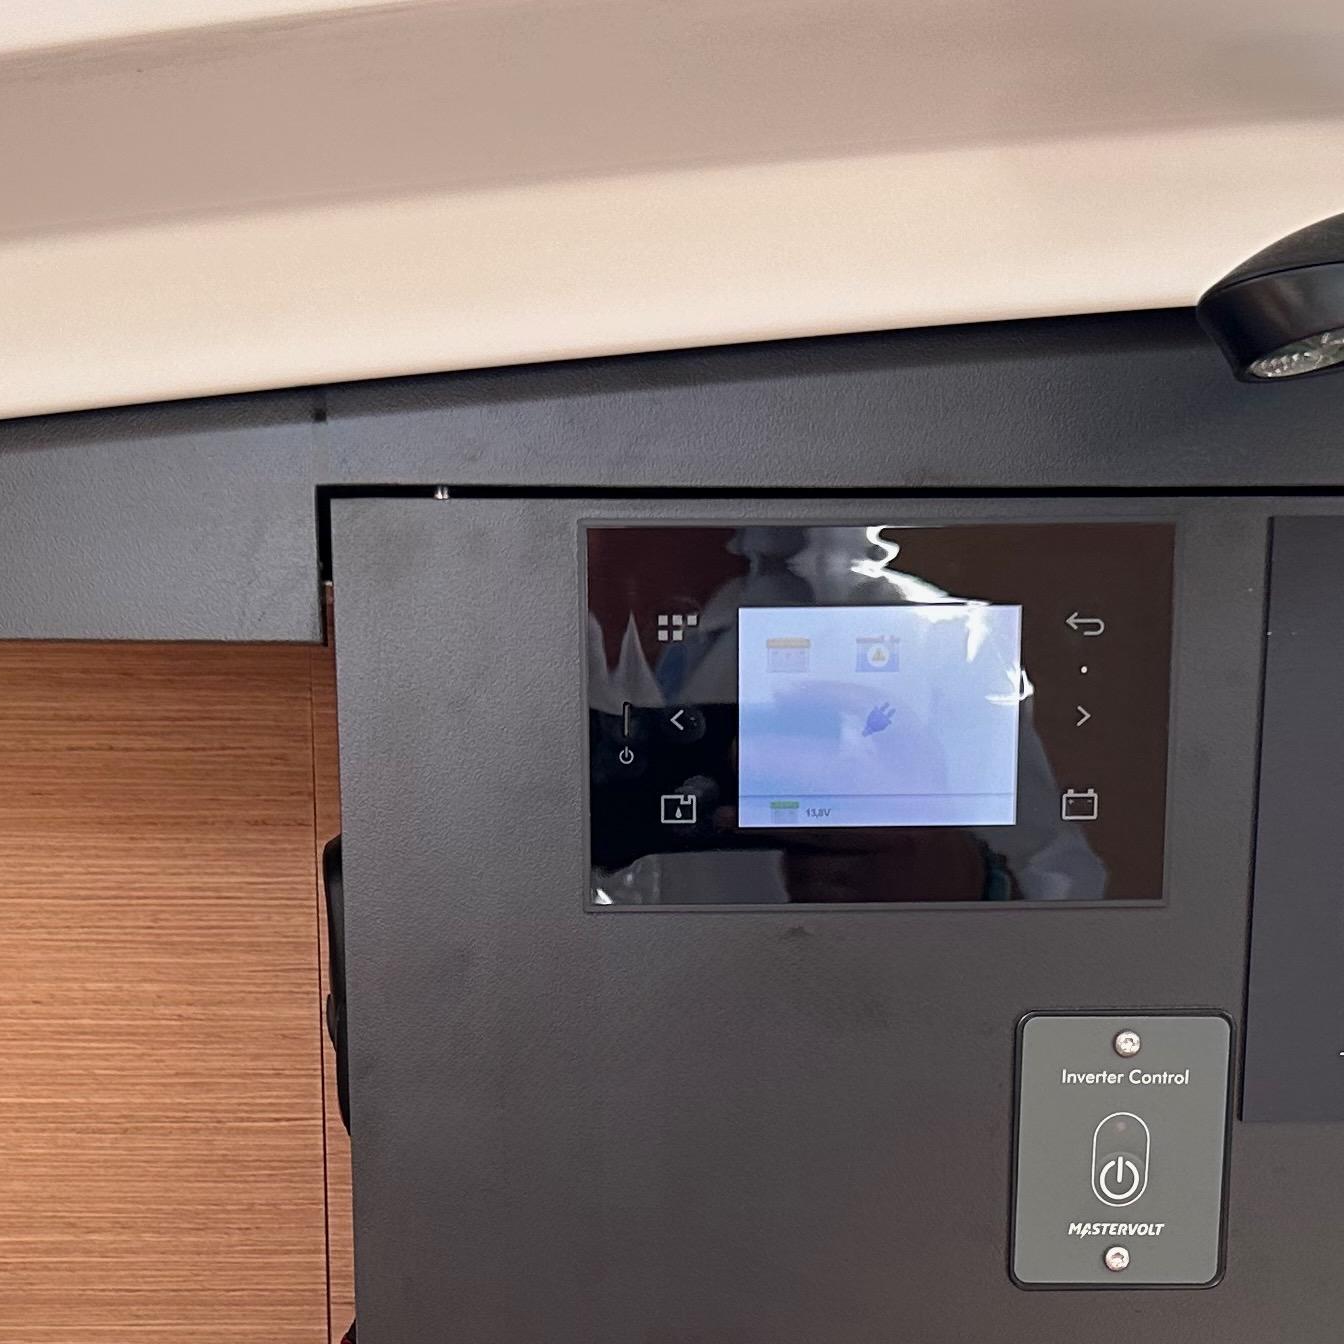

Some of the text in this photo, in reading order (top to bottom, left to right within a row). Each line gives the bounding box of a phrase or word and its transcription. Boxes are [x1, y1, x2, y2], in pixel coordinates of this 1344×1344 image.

[1062, 1069, 1190, 1085] Inverter Control
[1068, 1222, 1165, 1239] MASTERVOLT
